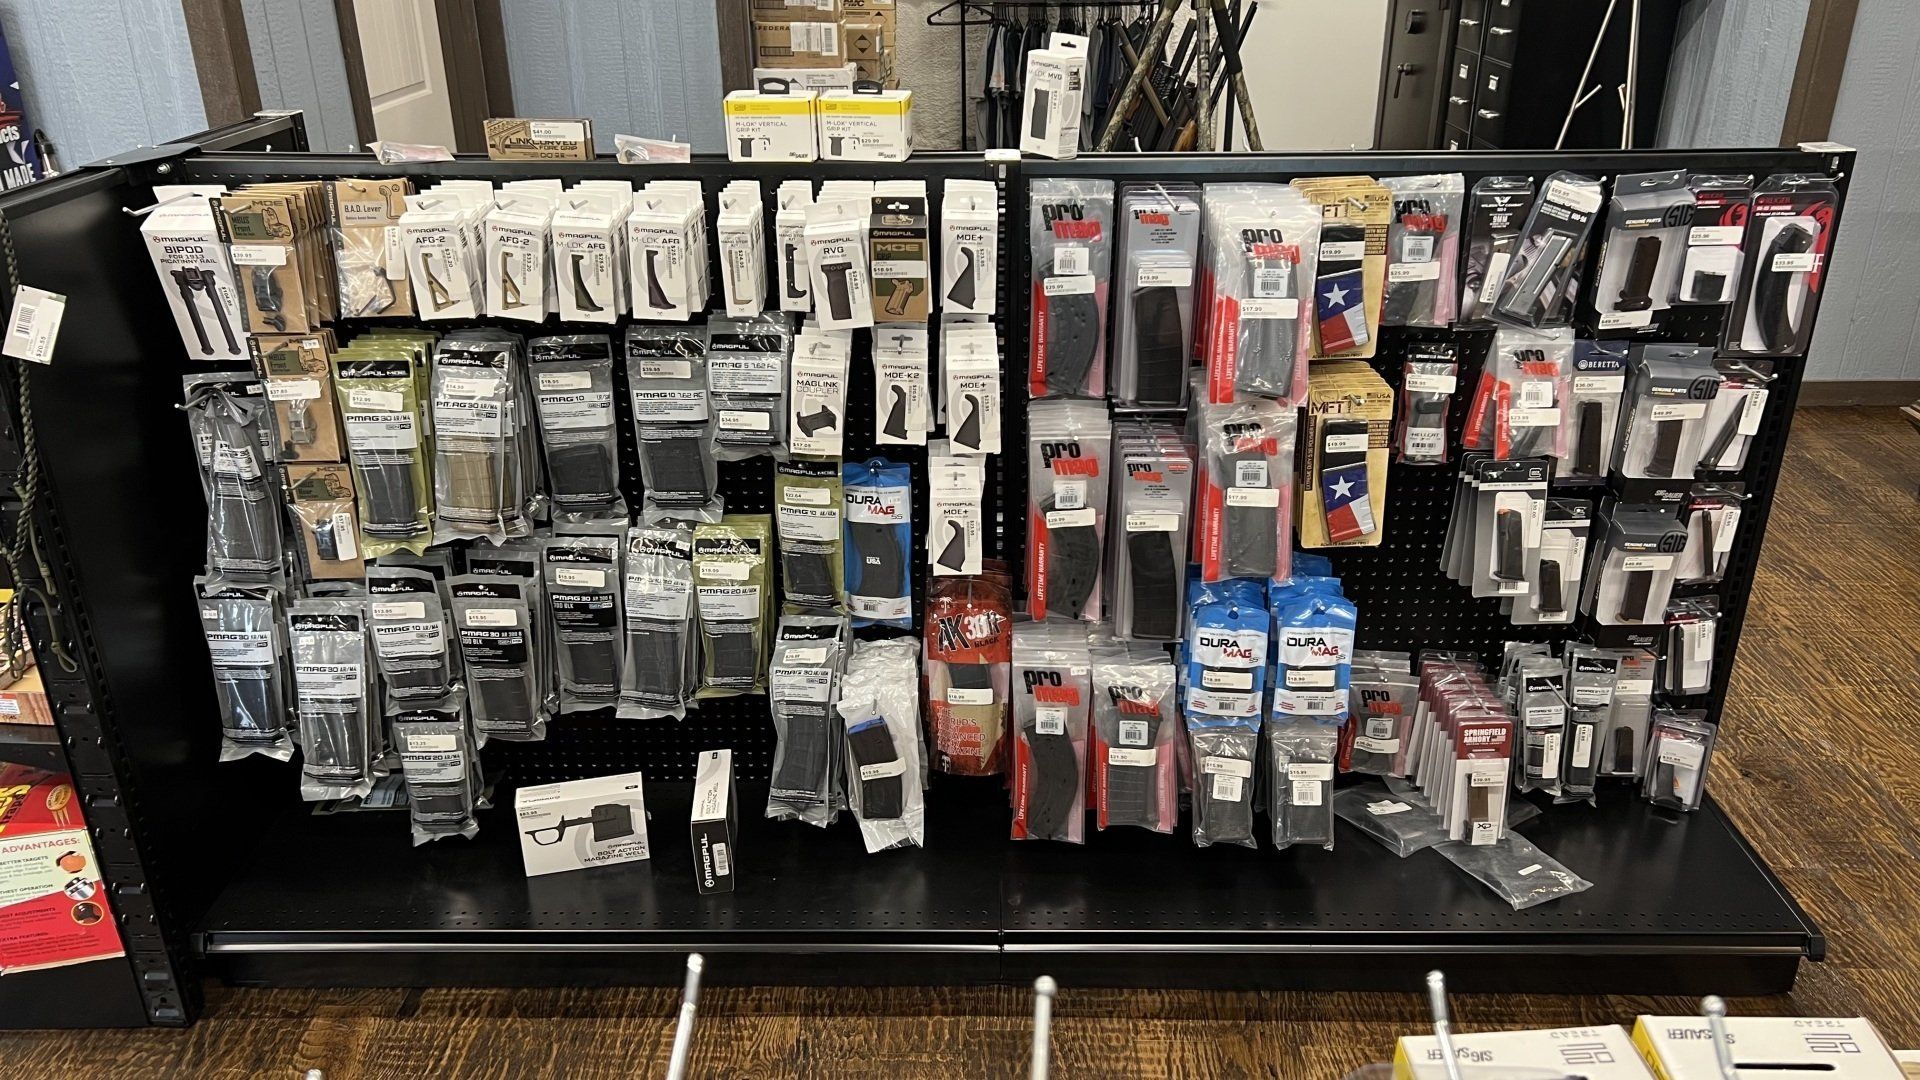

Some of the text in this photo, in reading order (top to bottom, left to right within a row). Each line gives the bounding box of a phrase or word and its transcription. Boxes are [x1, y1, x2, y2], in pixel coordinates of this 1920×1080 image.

[1048, 72, 1062, 81] MVG
[4, 163, 37, 189] MADE
[329, 191, 337, 226] MAGPUL
[344, 205, 382, 213] B.A.D. Lever
[1041, 203, 1085, 232] pro
[1140, 214, 1170, 226] mag
[1666, 204, 1695, 227] SIG
[213, 207, 226, 241] MAGPUL
[499, 227, 536, 236] MAGPUL
[1053, 220, 1102, 243] mag
[415, 236, 446, 244] AFG-2
[499, 236, 530, 246] AFG-2
[556, 241, 585, 249] M-LOK
[632, 236, 660, 244] M-LOK
[817, 237, 854, 245] MAGPUL
[1241, 228, 1284, 253] pro
[164, 246, 204, 254] BIPOD
[823, 247, 844, 255] RVG
[876, 243, 919, 252] MOE
[1036, 311, 1045, 373] LIFETIME WARRANTY
[1225, 322, 1236, 380] LIFETIME WARRANTY
[711, 361, 742, 369] PMAG
[1588, 360, 1620, 368] BERETTA
[796, 379, 838, 388] MAGLINK
[796, 386, 839, 394] COUPLER
[1311, 401, 1344, 414] MFT
[1040, 442, 1081, 469] pro
[785, 468, 816, 476] MAGPUL
[1053, 458, 1100, 477] mag
[1127, 463, 1152, 476] pro
[1134, 471, 1163, 482] mag
[845, 494, 882, 506] DURA
[780, 506, 808, 515] PMAG
[868, 505, 895, 515] MAG
[1210, 508, 1220, 561] LIFETIME WARRANTY
[1038, 543, 1046, 573] WARRANTY
[937, 613, 970, 652] AK
[974, 636, 1000, 648] BLACK
[1200, 637, 1240, 648] DURA
[1286, 637, 1327, 647] DURA
[1223, 647, 1254, 659] MAG
[1310, 646, 1340, 656] MAG
[1023, 670, 1062, 694] pro
[1034, 685, 1080, 707] mag
[1108, 685, 1143, 705] pro
[1361, 689, 1390, 707] pro
[1368, 701, 1404, 715] mag
[1464, 728, 1507, 736] SPRINGFIELD
[1, 837, 81, 854] ADVANTAGES:
[597, 846, 646, 857] BOLT ACTION
[20, 855, 49, 863] TARGETS
[584, 850, 647, 863] MAGAZINE WELL
[699, 833, 709, 881] MAGPUL
[23, 884, 54, 893] OPERATION
[1667, 1028, 1712, 1040] SAUER
[1471, 1051, 1493, 1062] SIG
